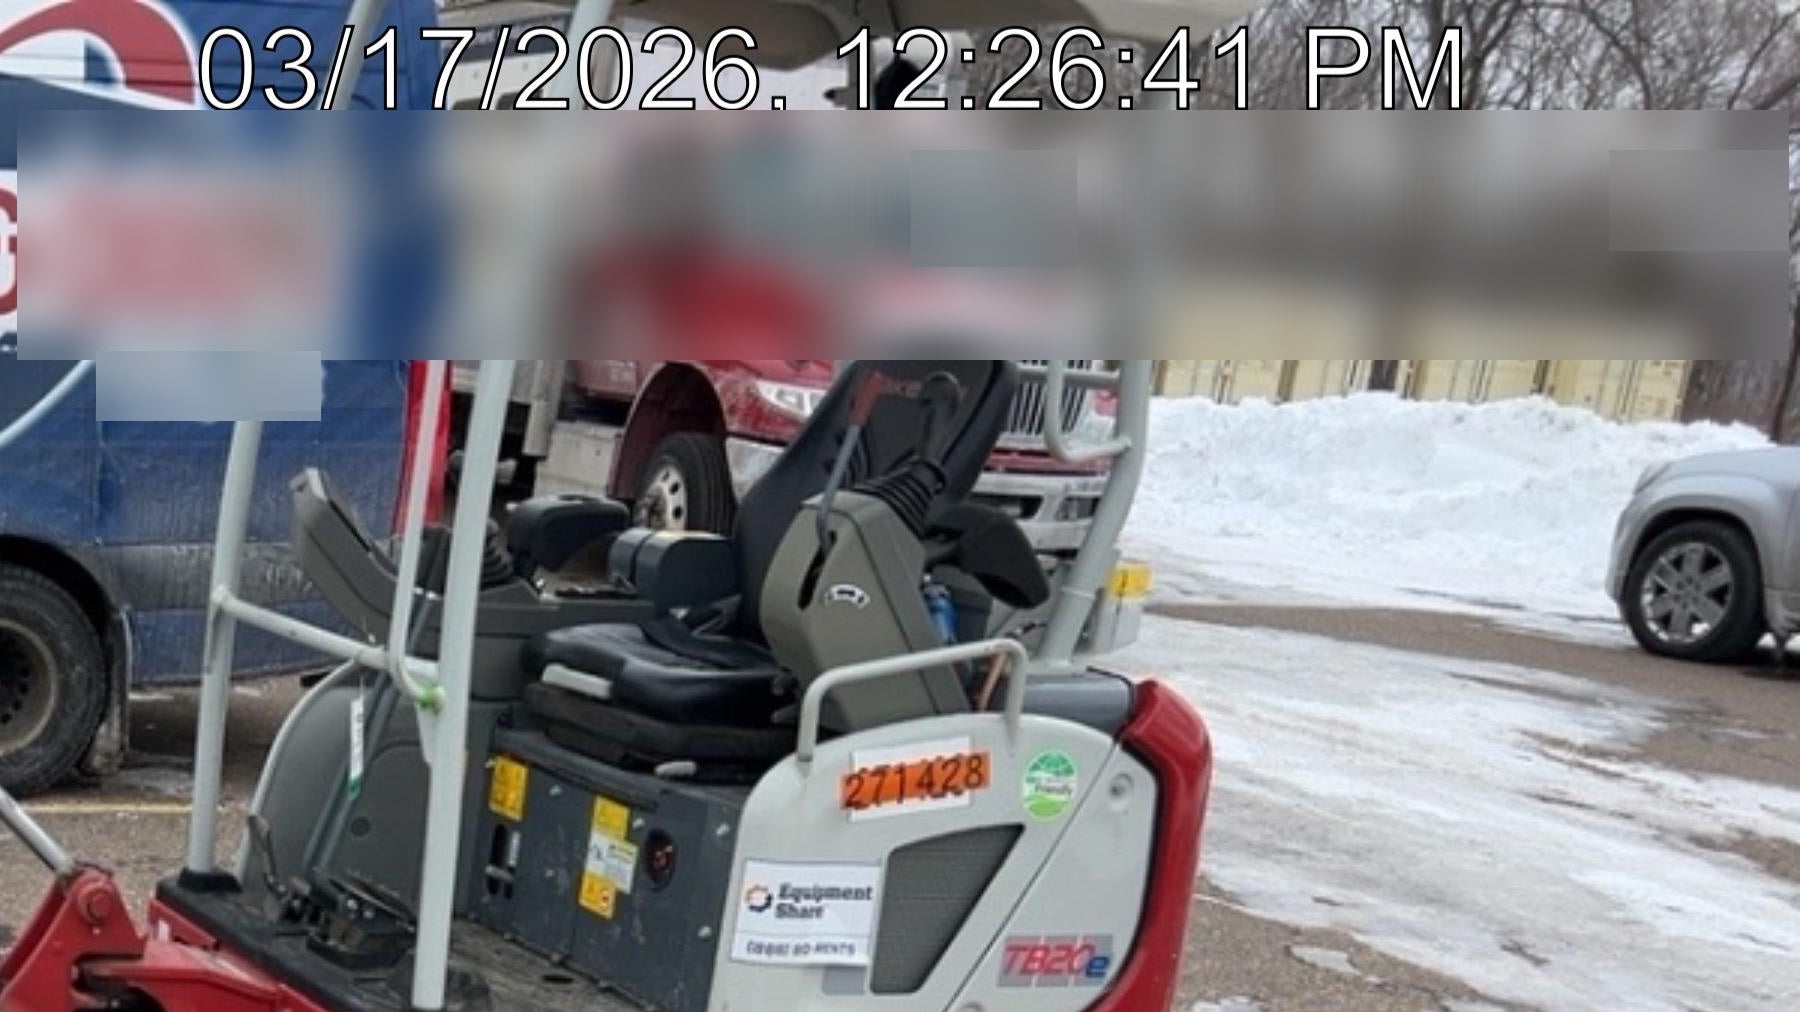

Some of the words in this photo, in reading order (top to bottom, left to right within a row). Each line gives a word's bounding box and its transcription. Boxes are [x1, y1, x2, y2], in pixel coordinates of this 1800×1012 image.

[844, 753, 984, 810] 271428
[777, 882, 873, 903] Equipment
[1003, 943, 1111, 978] TB20e
